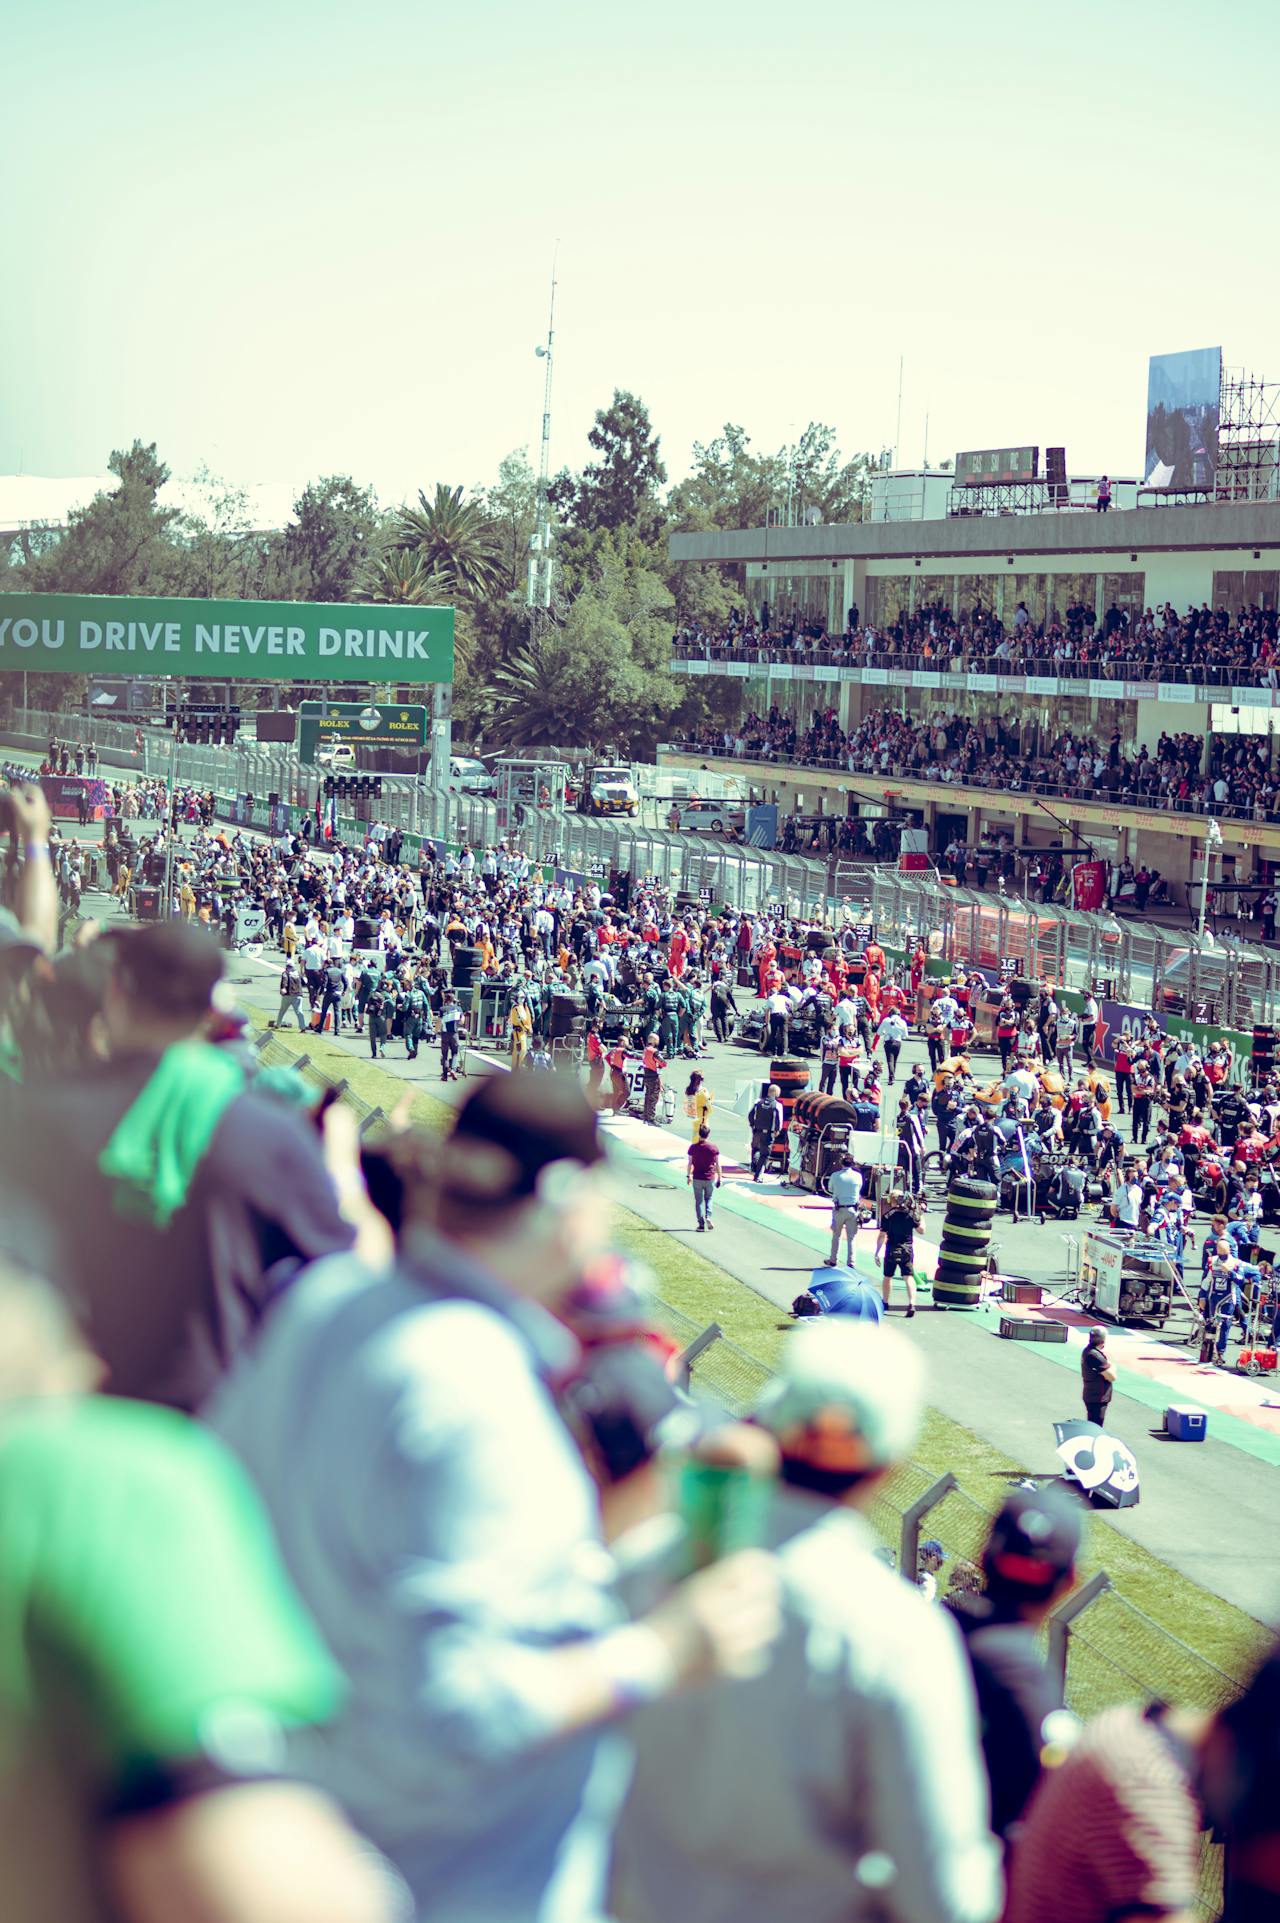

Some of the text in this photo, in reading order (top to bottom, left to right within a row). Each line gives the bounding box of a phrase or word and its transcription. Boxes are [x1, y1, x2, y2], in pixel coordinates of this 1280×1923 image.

[80, 622, 181, 651] DRIVE
[195, 624, 306, 655] NEVER
[318, 628, 430, 659] DRINK
[319, 720, 350, 728] ROLEX
[389, 722, 419, 730] ROLEX
[1000, 959, 1016, 970] 16
[1197, 1003, 1207, 1015] 7
